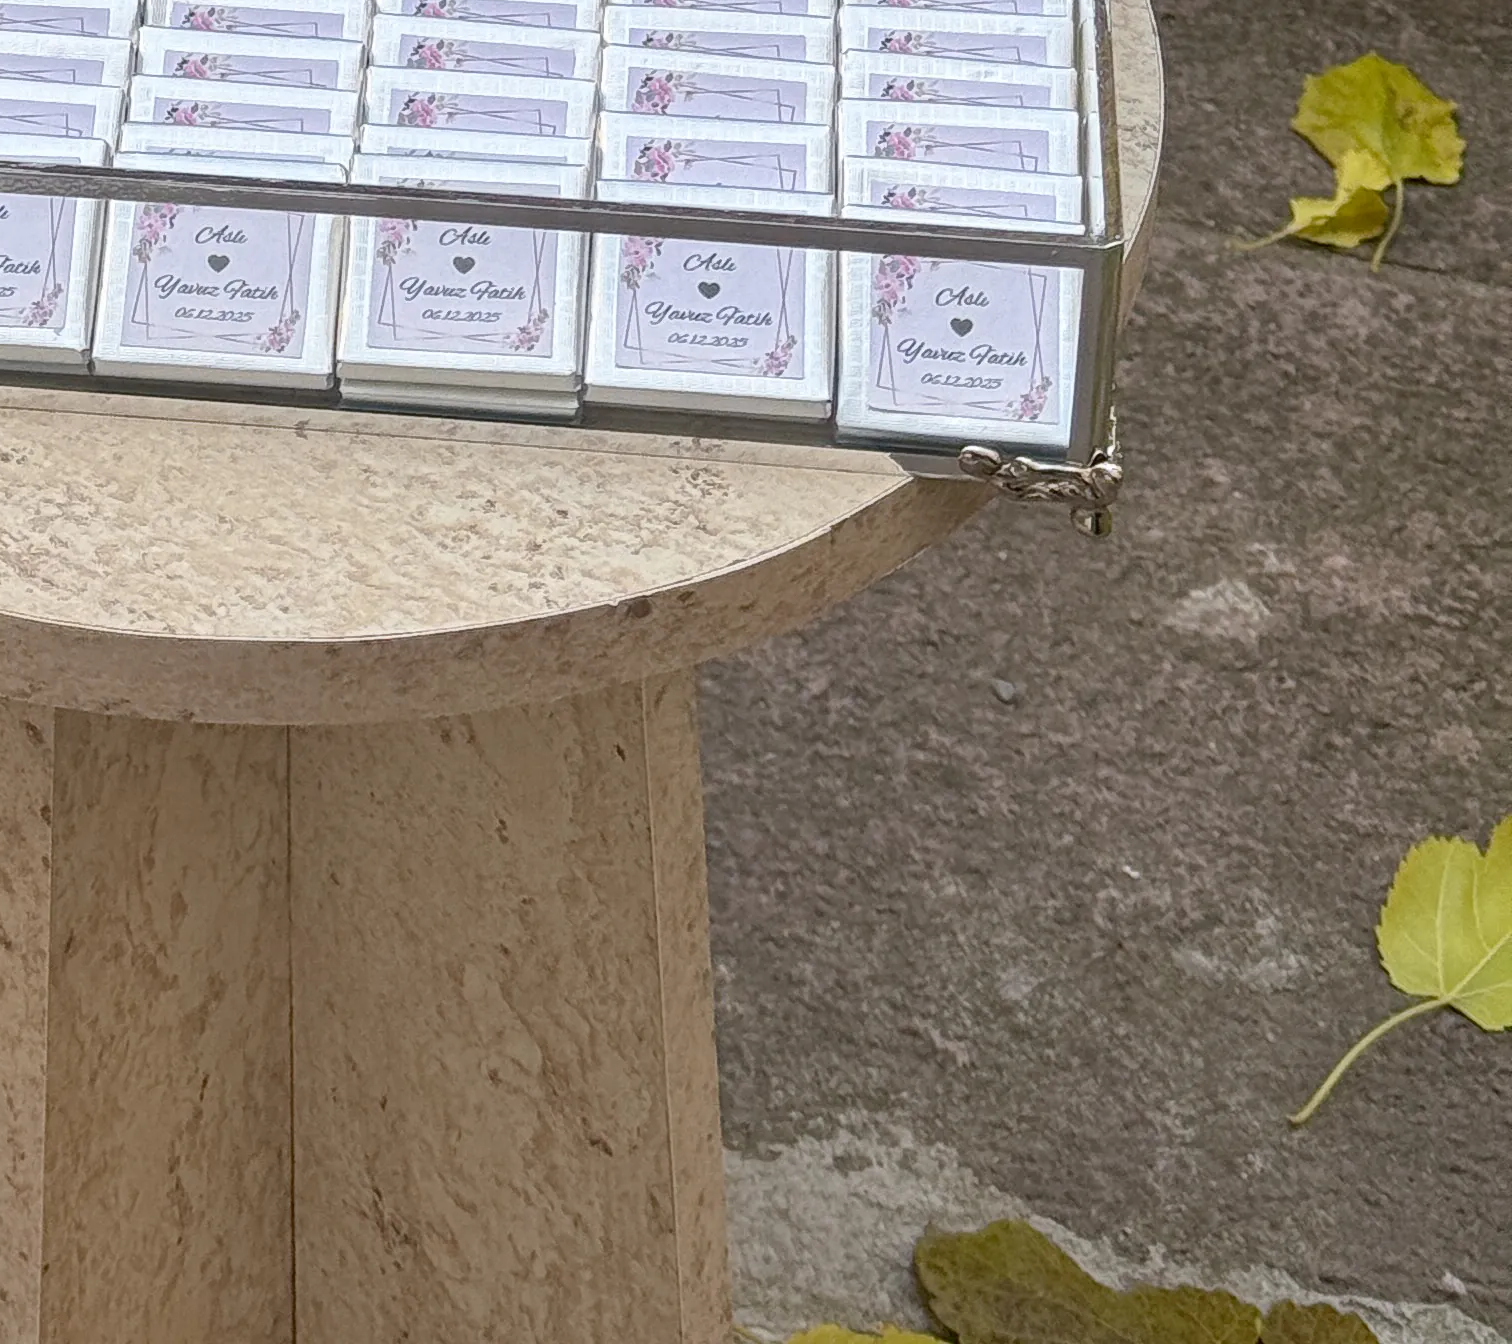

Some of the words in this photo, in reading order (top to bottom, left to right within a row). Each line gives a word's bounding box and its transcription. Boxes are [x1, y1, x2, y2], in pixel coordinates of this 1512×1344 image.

[154, 274, 220, 299] Yavuz
[223, 279, 279, 300] Fatih
[399, 276, 467, 301] Yavuz
[469, 280, 526, 301] Fatih
[644, 301, 714, 325] Yavuz
[715, 306, 774, 326] Fatih
[896, 338, 966, 364] Yavuz
[968, 344, 1028, 366] Fatih
